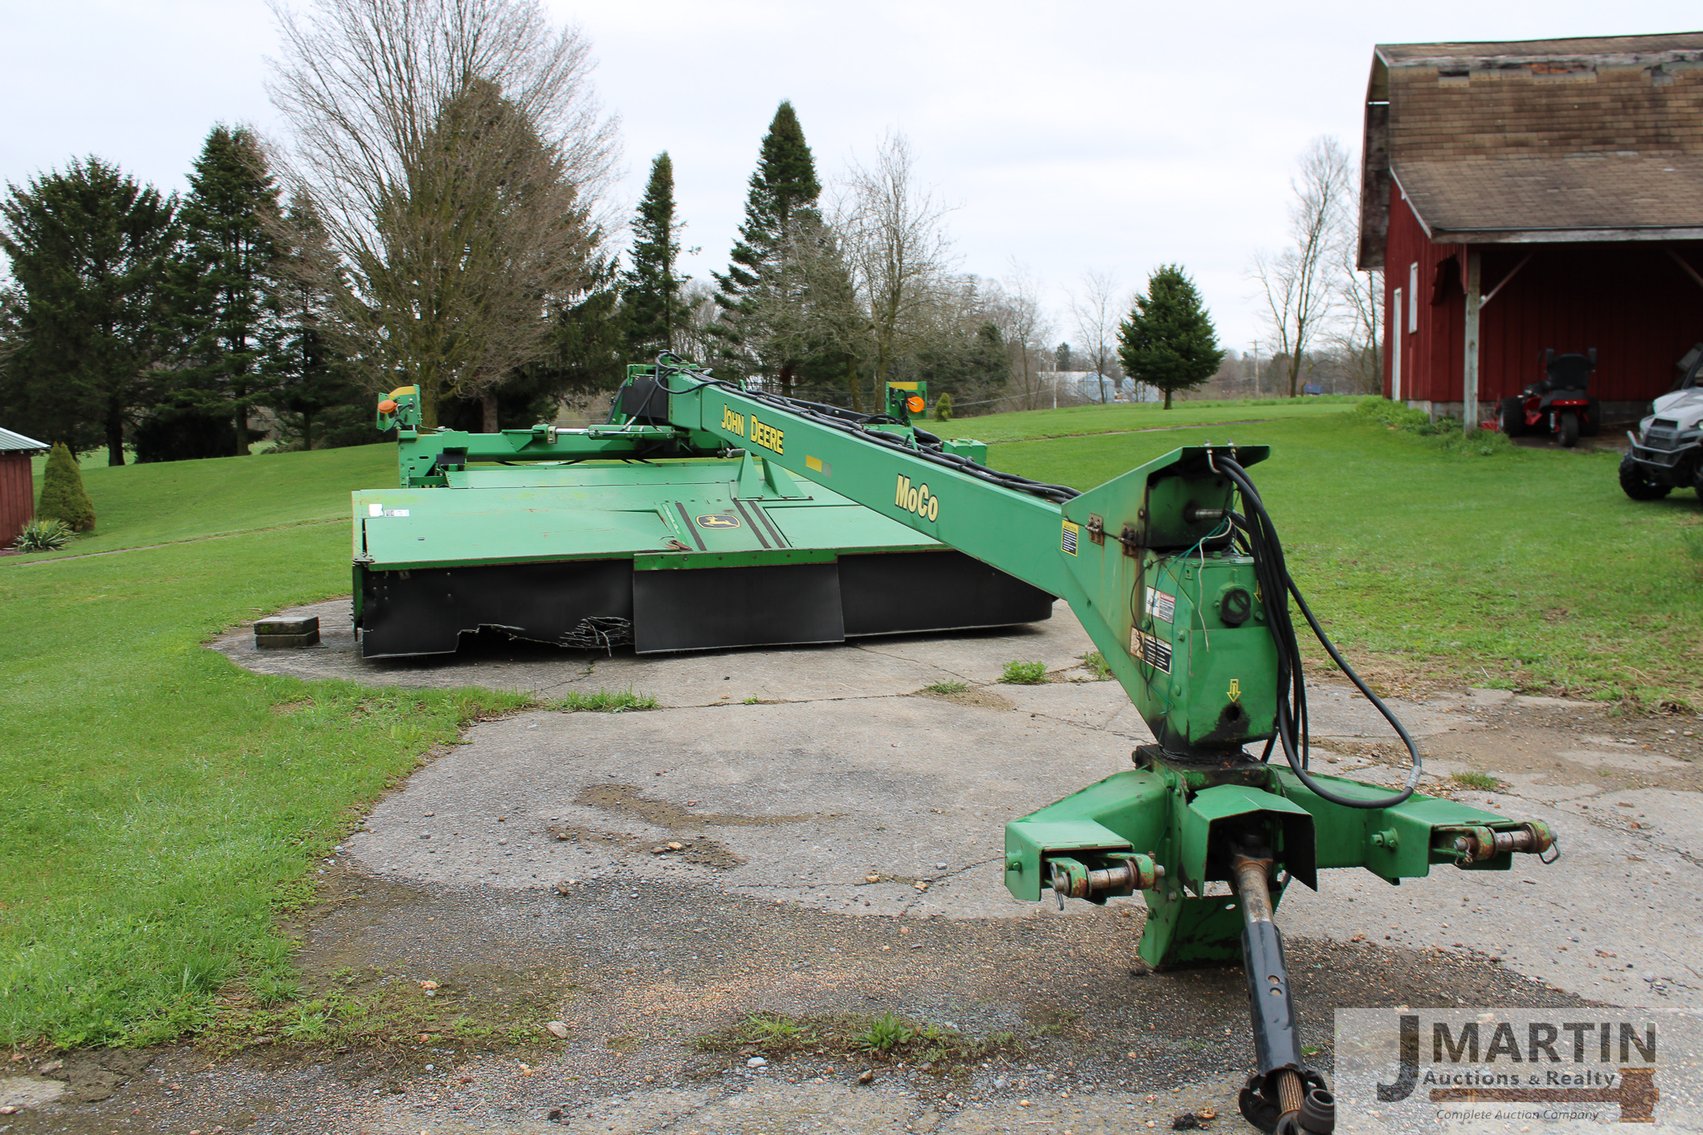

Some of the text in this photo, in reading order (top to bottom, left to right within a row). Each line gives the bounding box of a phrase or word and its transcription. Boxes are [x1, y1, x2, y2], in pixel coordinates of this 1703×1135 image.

[721, 404, 784, 455] JOHN DEERE
[895, 474, 939, 523] MoCo
